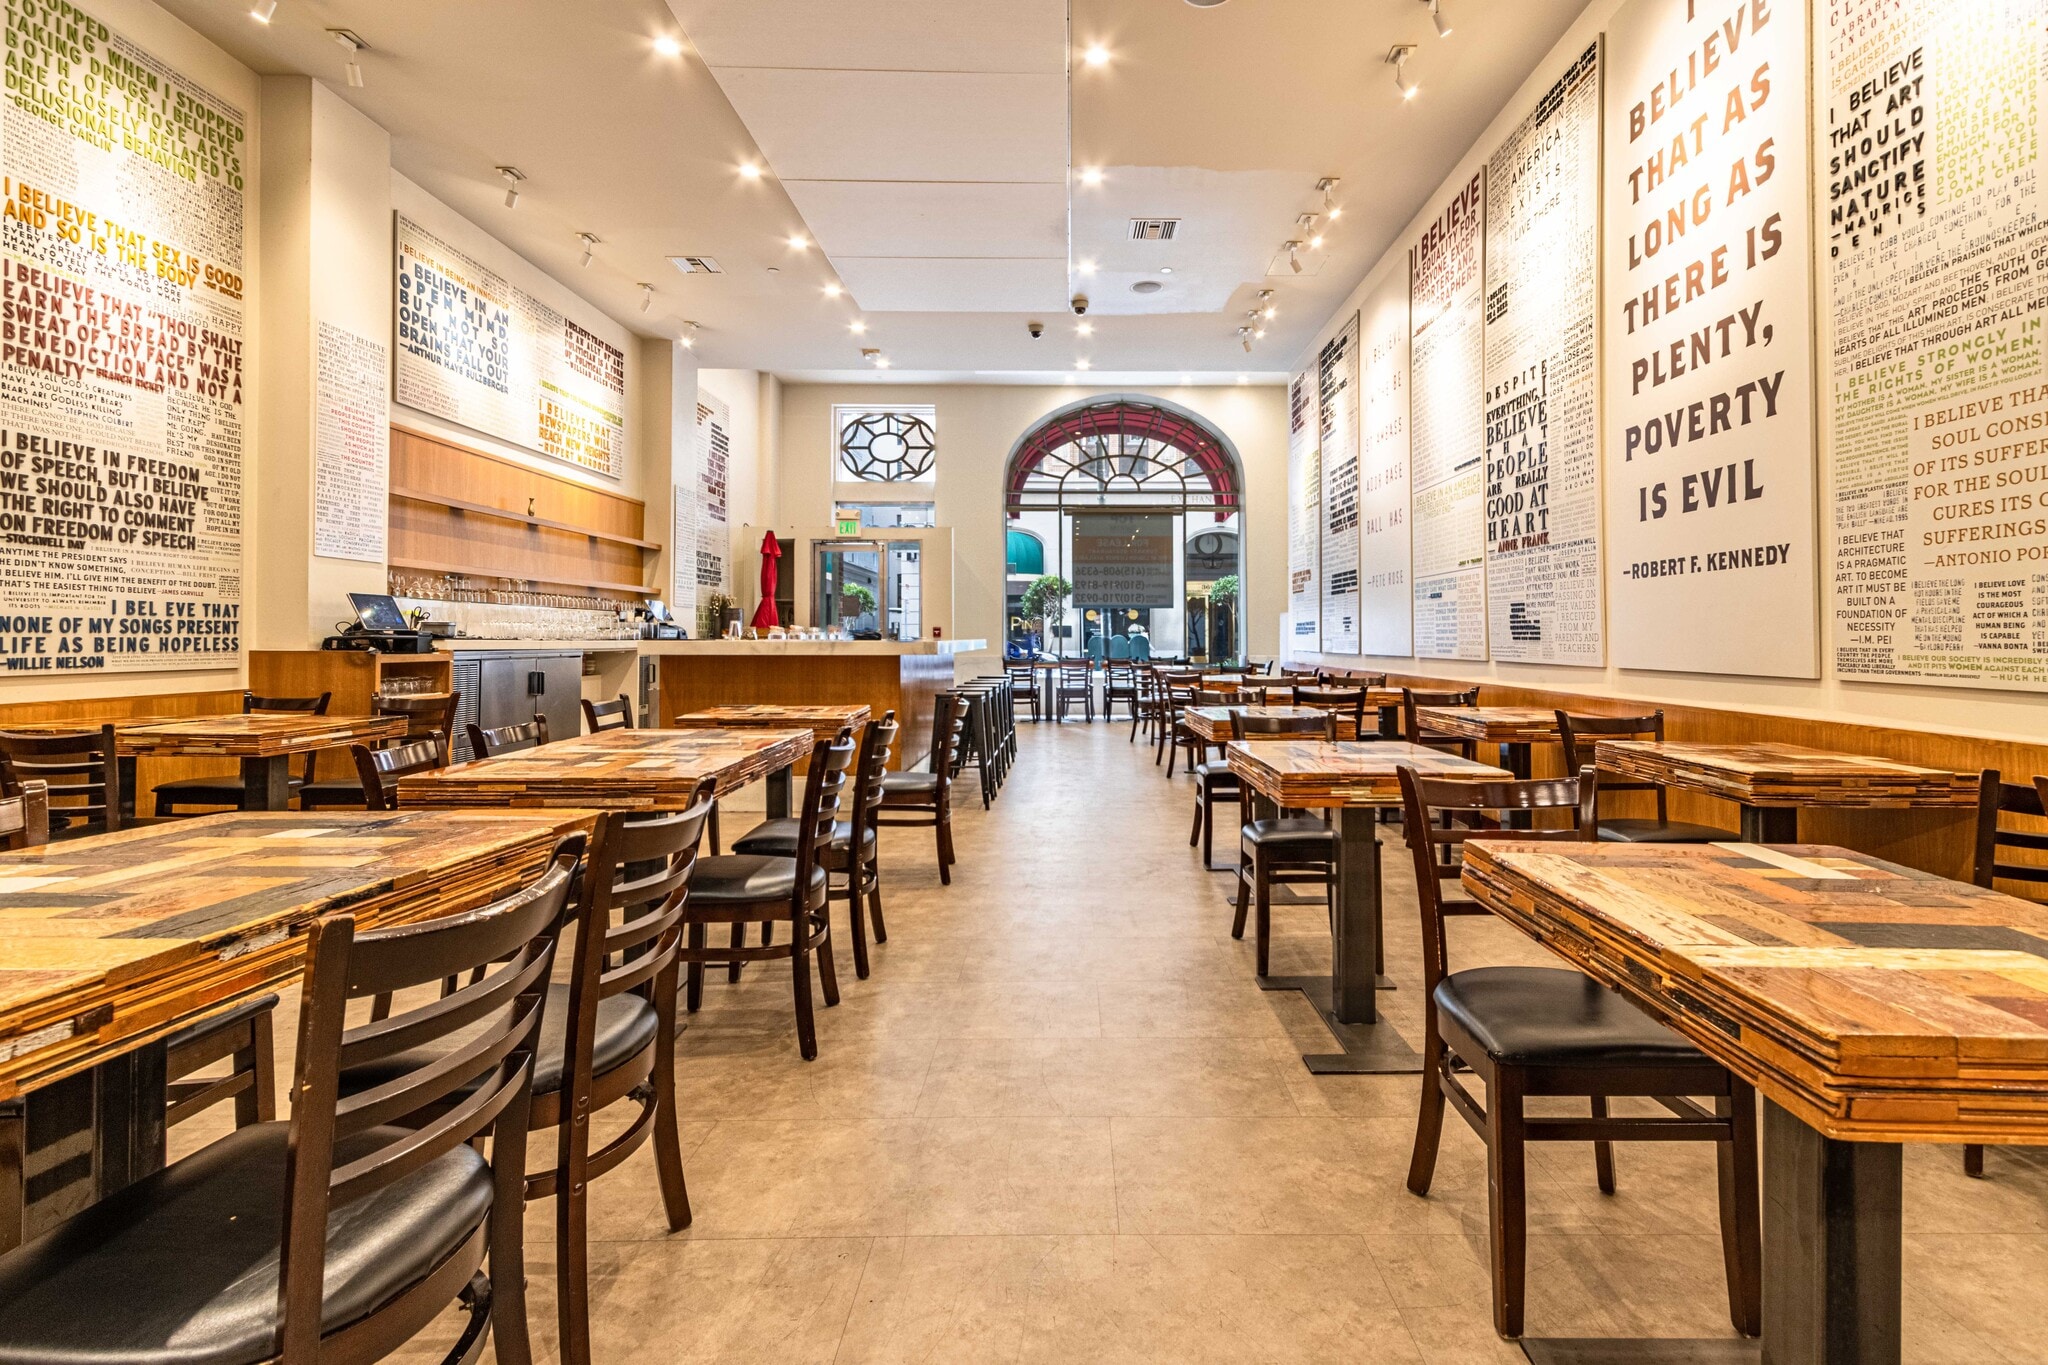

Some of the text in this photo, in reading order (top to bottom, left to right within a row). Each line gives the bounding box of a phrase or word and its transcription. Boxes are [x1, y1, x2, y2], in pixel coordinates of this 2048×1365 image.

[1687, 0, 1694, 23] I
[5, 6, 82, 65] TAKING
[90, 57, 155, 108] DRUGS.
[162, 99, 167, 115] I
[174, 107, 235, 155] BELIEVE
[1630, 0, 1772, 144] BELIEVE
[1830, 47, 1923, 123] I BELIEVE
[108, 48, 158, 92] WHEN
[165, 83, 170, 100] I
[176, 91, 243, 142] STOPPED
[1830, 75, 1924, 148] THAT ART
[5, 69, 118, 143] DELUSIONAL
[124, 135, 196, 183] BEHAVIOR
[70, 124, 112, 153] CARLIN
[1628, 112, 1708, 205] THAT
[1722, 62, 1770, 136] AS
[1830, 106, 1923, 175] SHOULD
[1830, 132, 1925, 199] SANCTIFY
[1629, 136, 1774, 271] LONG AS
[1831, 160, 1925, 226] NATURE
[4, 177, 243, 292] I BELIEVE THAT SEX IS GOOD
[1413, 172, 1480, 269] I BELIEVE
[4, 199, 197, 290] AND SO IS THE BODY
[1413, 209, 1476, 282] IN EQUALITY FOR
[400, 255, 509, 327] I BELIEVE IN AN
[1623, 212, 1782, 335] THERE IS
[400, 273, 509, 341] OPEN MIND.
[400, 289, 509, 355] BUT NOT SO
[399, 323, 509, 383] BRAINS FALL OUT
[400, 308, 509, 370] OPEN THAT YOUR
[1632, 300, 1773, 396] PLENTY,
[444, 361, 464, 376] HAYS
[1486, 360, 1548, 404] DESPITE
[1541, 375, 1547, 397] I
[1486, 401, 1548, 446] BELIEVE
[1626, 370, 1784, 462] POVERTY
[1914, 417, 1919, 430] I
[1924, 396, 2003, 428] BELIEVE
[1, 430, 200, 483] I BELIEVE IN FREEDOM
[1932, 428, 1980, 450] SOUL
[1, 451, 208, 500] OF SPEECH, BUT I BELIEVE
[1487, 442, 1548, 482] PEOPLE
[1487, 466, 1548, 497] ARE REALLY
[0, 471, 196, 516] WE SHOULD ALSO HAVE
[1487, 484, 1549, 519] GOOD AT
[1640, 458, 1764, 522] IS EVIL
[1933, 492, 2032, 521] CURES ITS
[1, 492, 195, 533] THE RIGHT TO COMMENT
[1, 513, 196, 550] ON FREEDOM OF SPEECH
[839, 521, 857, 534] EXIT
[1488, 508, 1549, 541] HEART
[68, 539, 85, 549] DAY
[1522, 532, 1549, 548] FRANK
[1838, 529, 1904, 545] I BELIEVE THAT
[1838, 543, 1904, 557] ARCHITECTURE
[1923, 520, 2046, 546] SUFFERINGS
[1690, 555, 1701, 574] F.
[1707, 543, 1790, 572] KENNEDY
[1836, 570, 1907, 582] ART. TO BECOME
[1846, 560, 1853, 568] A
[1855, 556, 1906, 568] PRAGMATIC
[1837, 583, 1906, 594] ART IT MUST BE
[1847, 597, 1895, 606] BUILT ON A
[0, 616, 239, 635] NONE OF MY SONGS PRESENT
[112, 600, 116, 614] I
[202, 603, 239, 618] THAT
[1837, 609, 1907, 619] FOUNDATION OF
[1847, 623, 1895, 631] NECESSITY
[0, 637, 239, 654] LIFE AS BEING HOPELESS
[1877, 636, 1891, 644] PEI
[56, 657, 104, 669] NELSON
